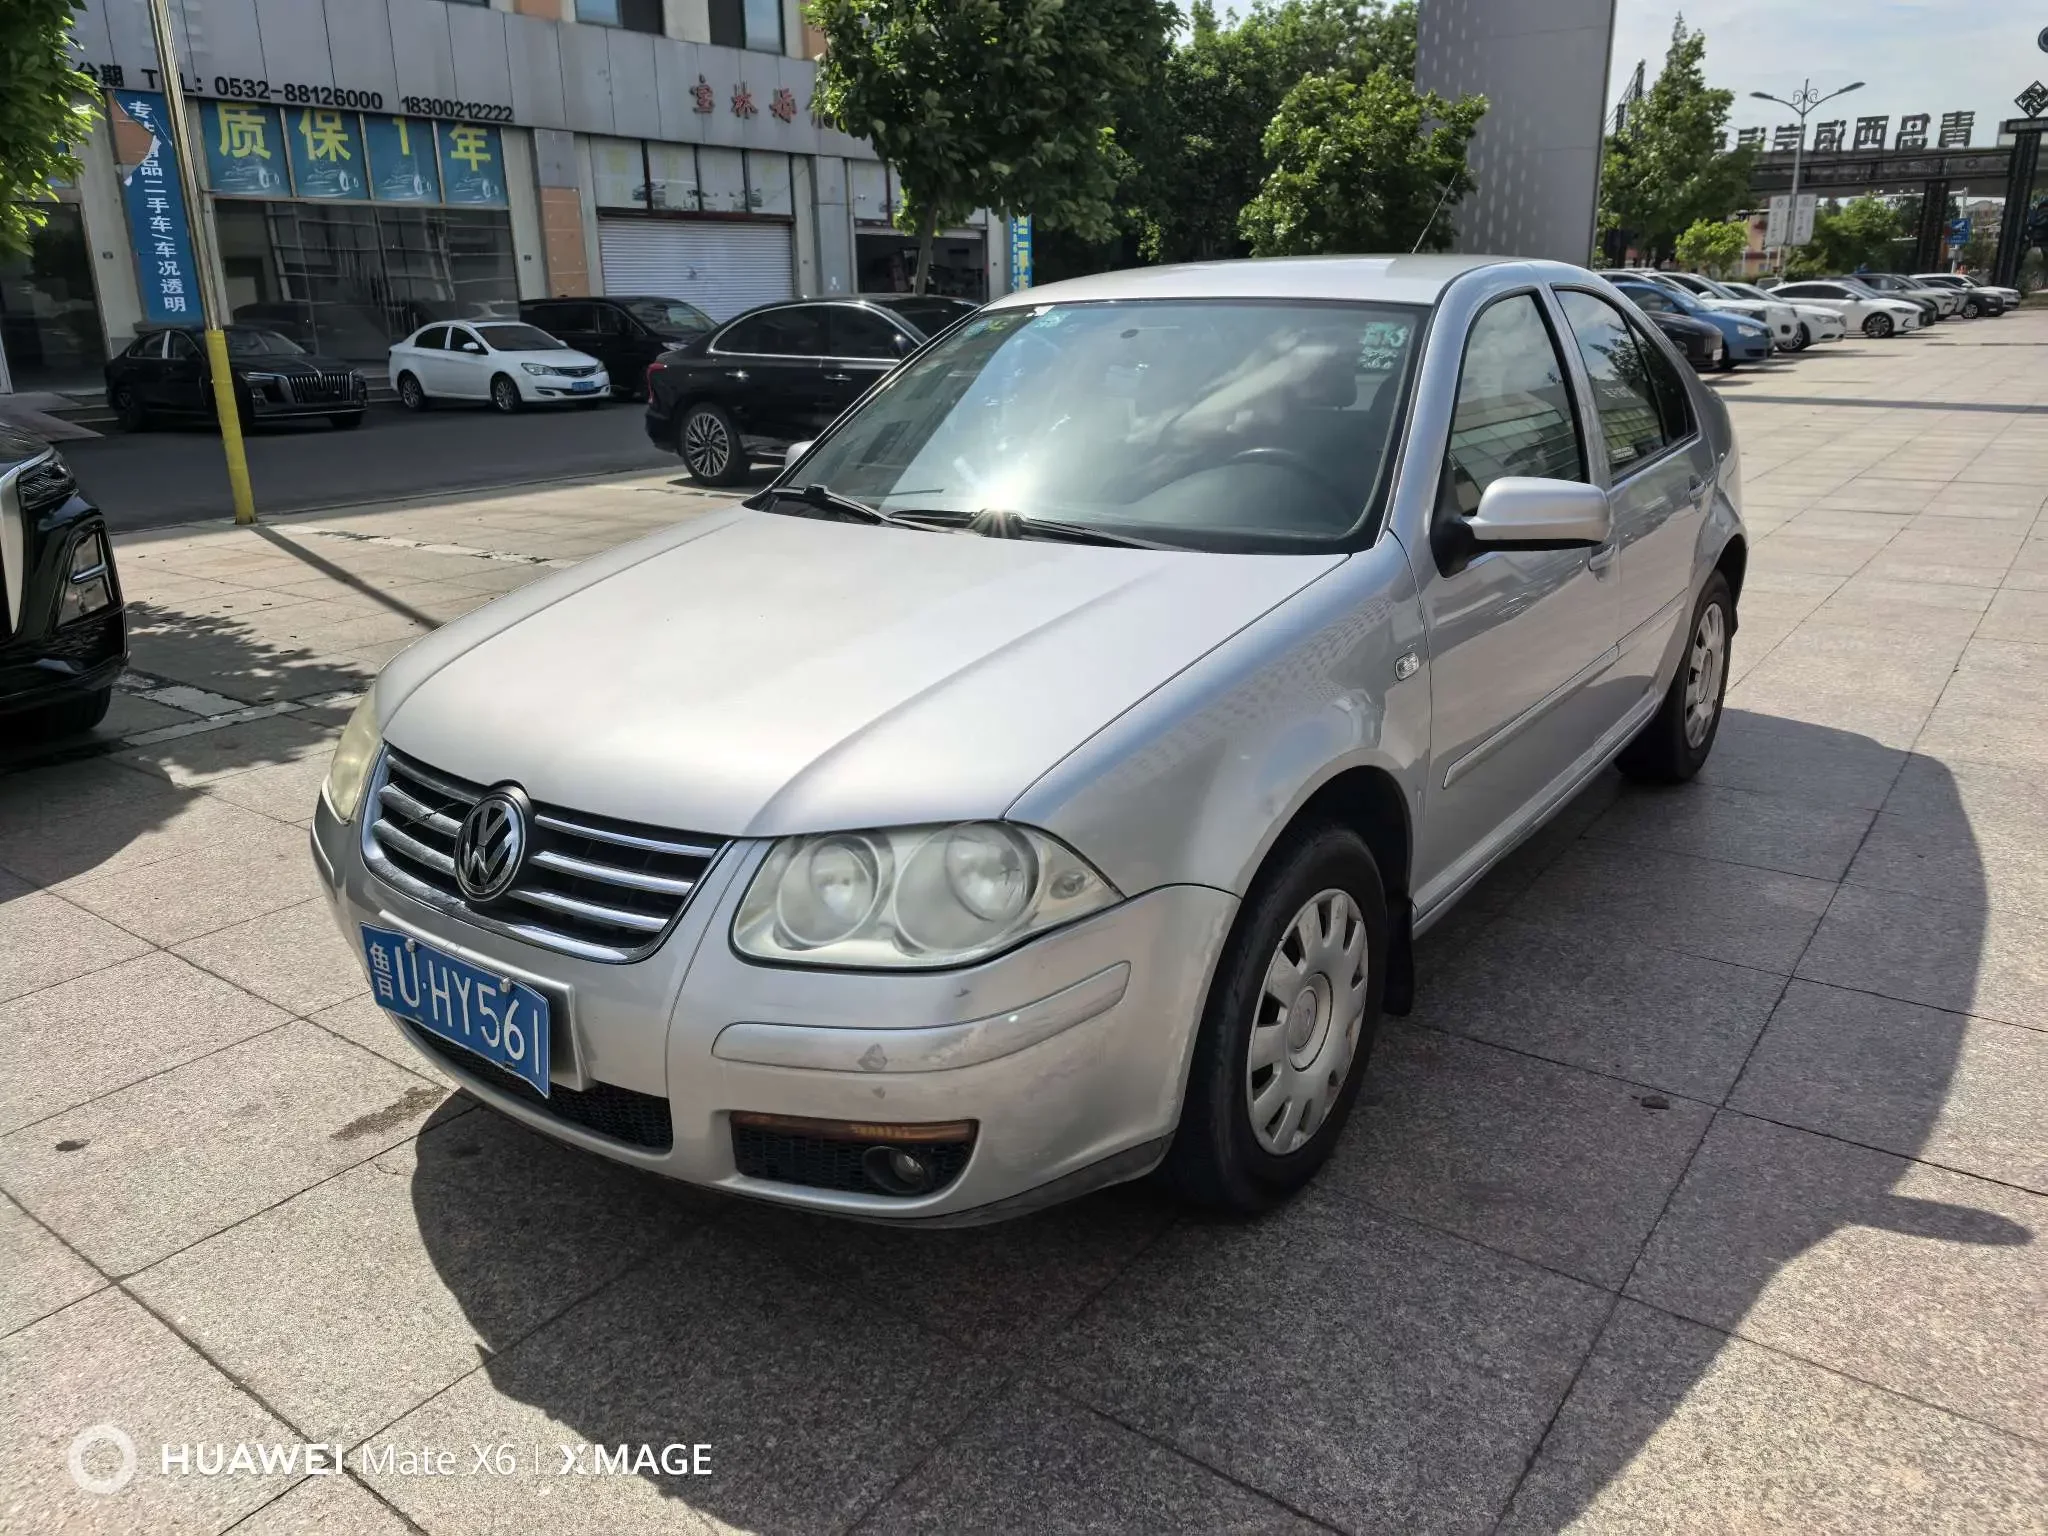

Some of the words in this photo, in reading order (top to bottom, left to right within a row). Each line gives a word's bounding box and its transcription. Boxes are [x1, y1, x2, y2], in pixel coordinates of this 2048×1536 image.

[141, 69, 203, 92] TL:
[214, 76, 383, 110] 0532-88126000
[401, 96, 514, 123] 18300212222
